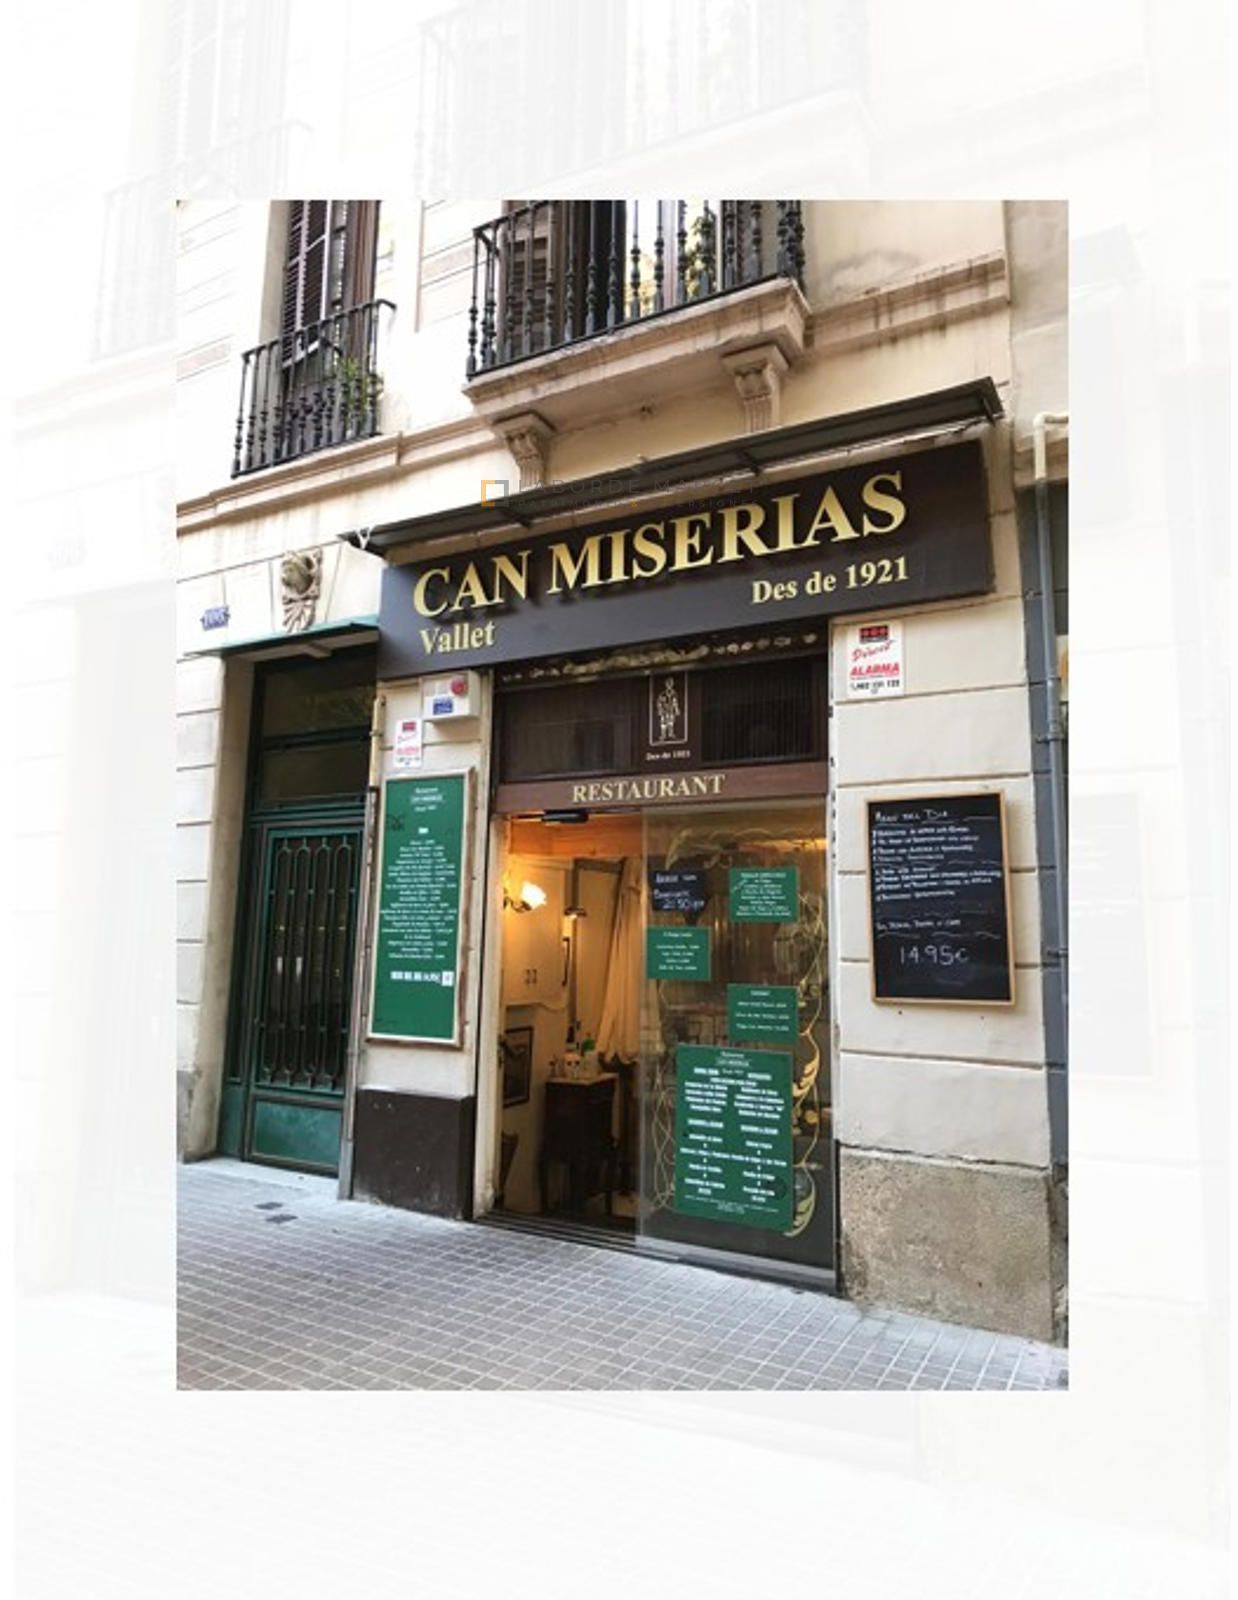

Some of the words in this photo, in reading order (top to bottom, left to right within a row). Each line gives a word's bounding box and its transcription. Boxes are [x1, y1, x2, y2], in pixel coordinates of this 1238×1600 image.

[413, 551, 529, 618] CAN
[547, 472, 907, 594] MISERIAS
[751, 577, 799, 604] Des
[804, 570, 837, 596] de
[845, 555, 909, 590] 1921
[419, 619, 496, 656] Vallet
[850, 662, 899, 676] ALARMA
[572, 773, 726, 803] RESTAURANT
